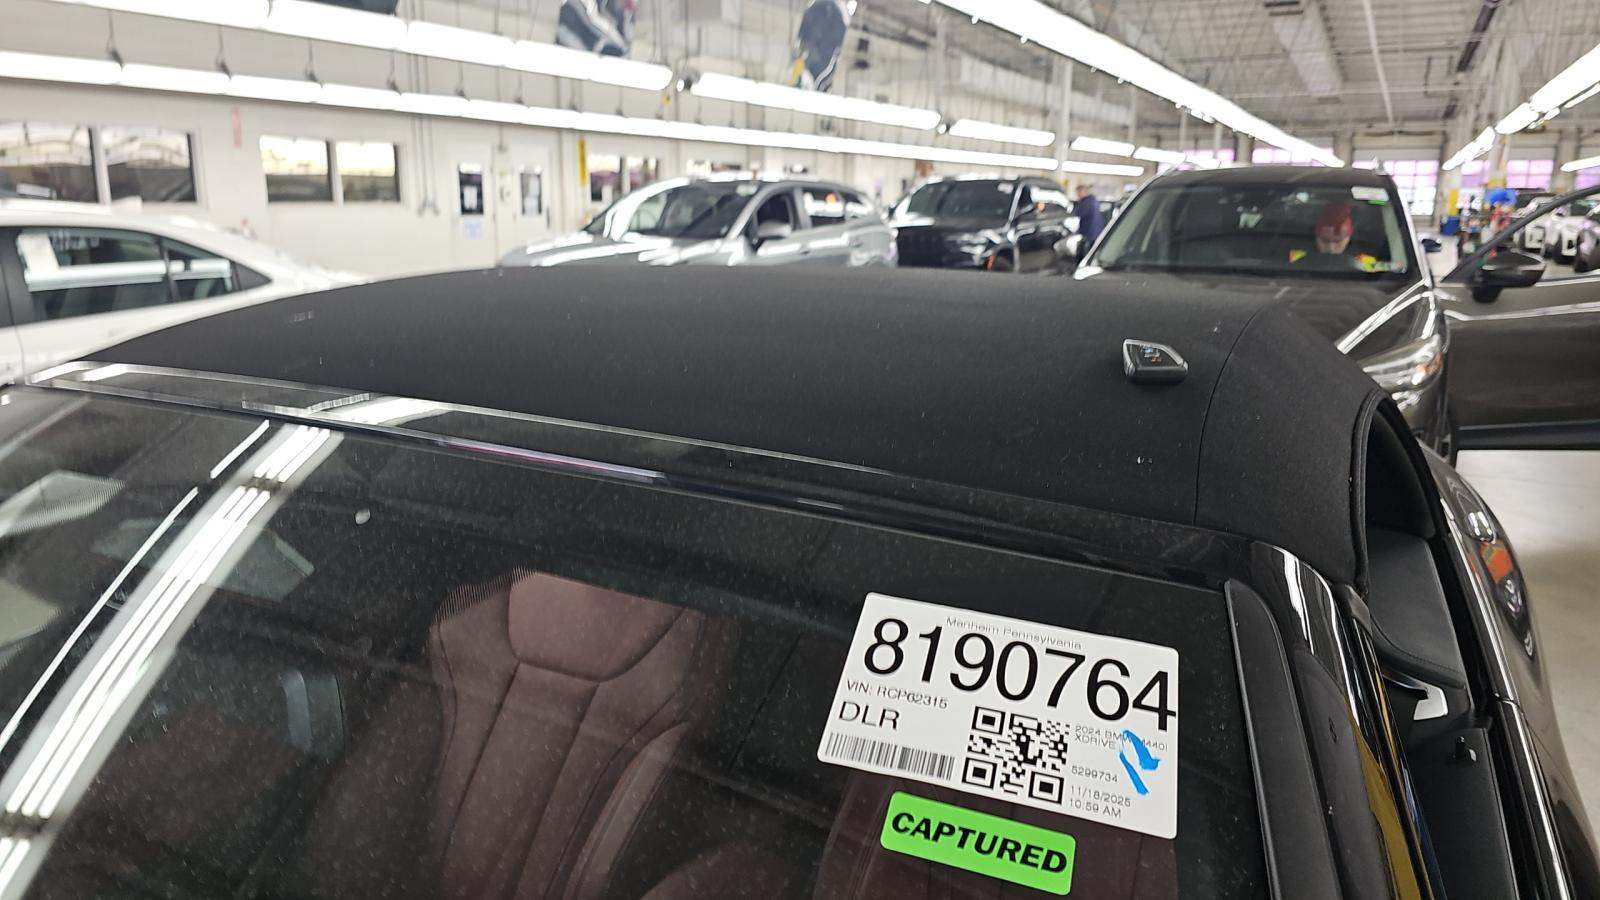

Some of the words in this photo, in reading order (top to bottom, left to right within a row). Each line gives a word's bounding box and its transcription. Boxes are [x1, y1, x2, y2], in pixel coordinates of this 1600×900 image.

[1003, 627, 1083, 650] Pennsylvania
[864, 618, 1177, 732] 8190764
[847, 680, 872, 695] VIN:
[877, 685, 948, 709] RCP62315
[839, 701, 900, 730] DLR
[1075, 725, 1101, 736] 2024
[1075, 733, 1116, 750] XDRIVE
[1071, 765, 1118, 783] 5299734
[1071, 785, 1131, 807] 11/18/2025
[1102, 805, 1121, 818] AM
[892, 812, 1068, 874] CAPTURED
